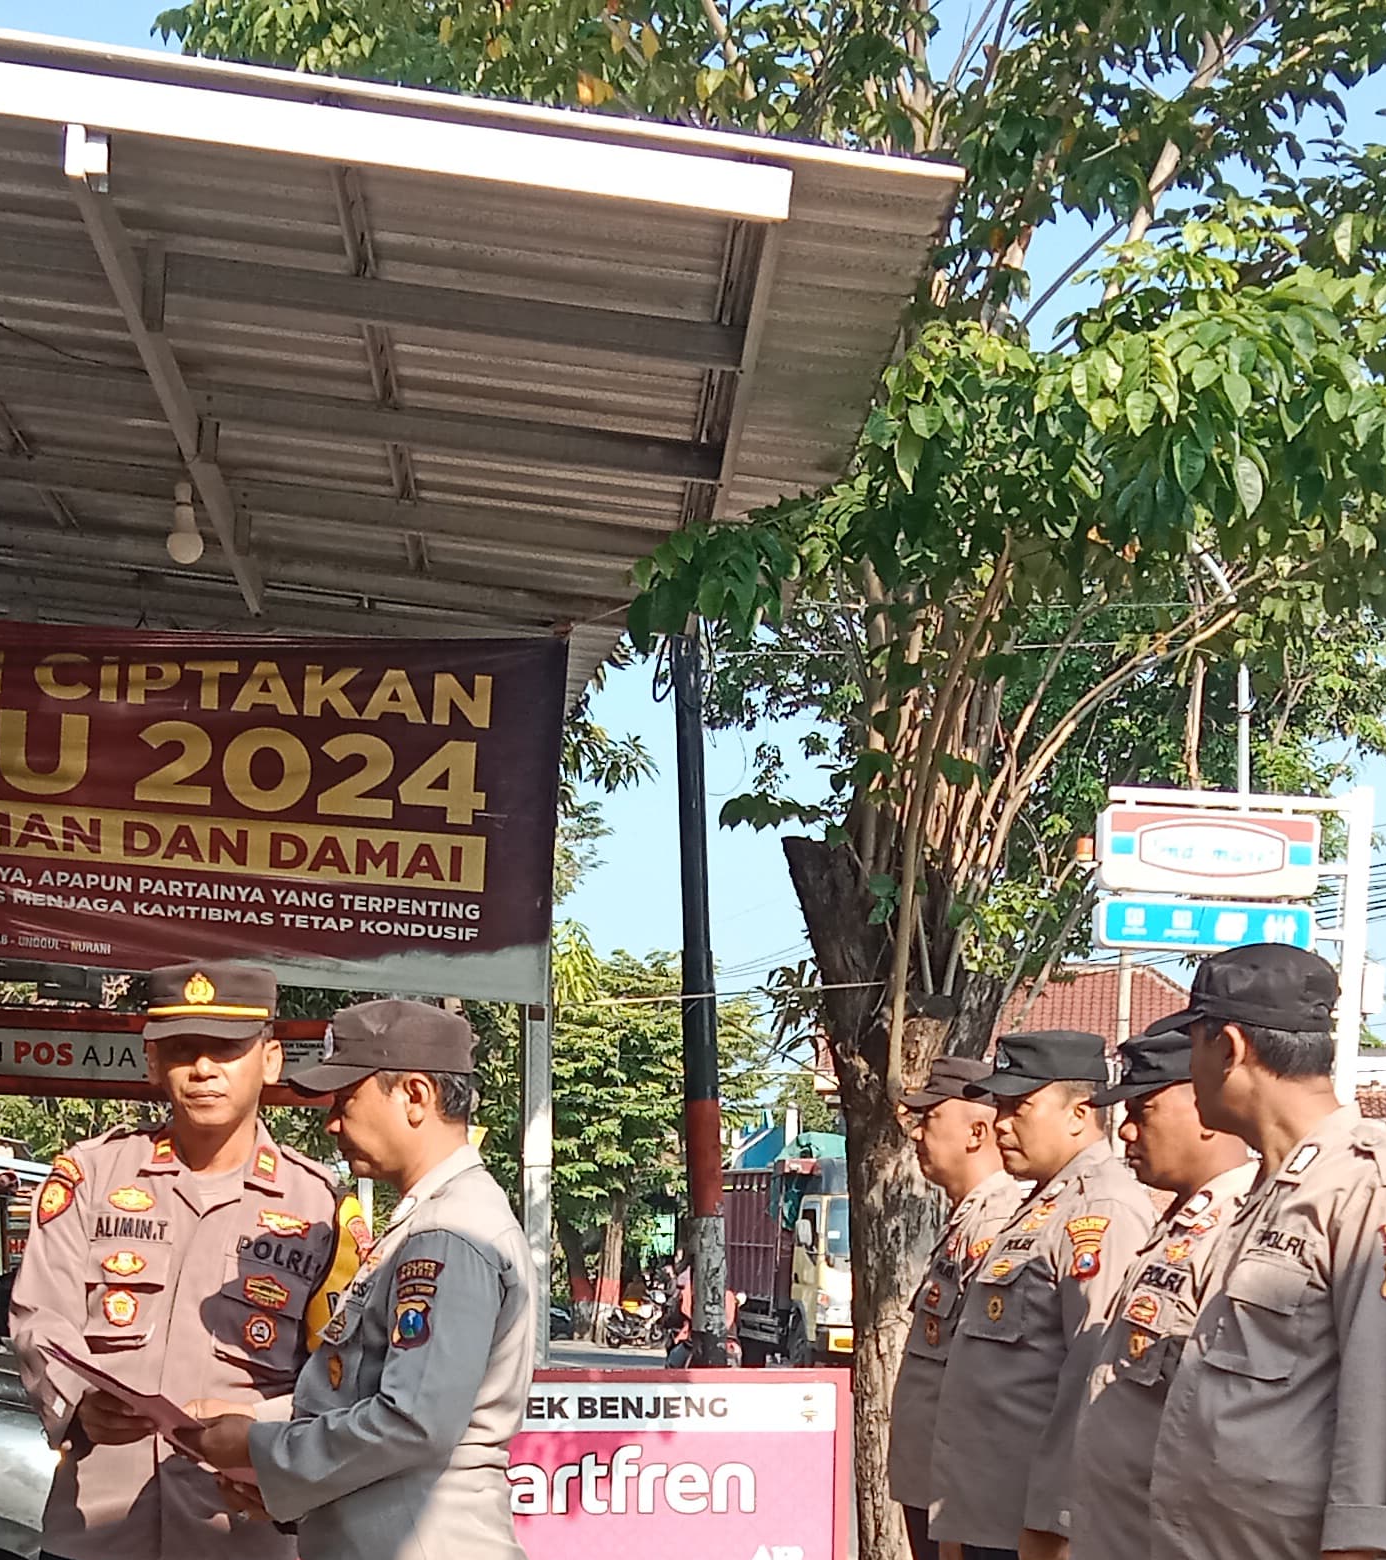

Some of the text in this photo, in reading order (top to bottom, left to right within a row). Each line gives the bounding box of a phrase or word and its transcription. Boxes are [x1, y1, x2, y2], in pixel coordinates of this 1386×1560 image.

[34, 651, 493, 729] CIPTAKAN
[133, 719, 486, 826] 2024
[122, 819, 249, 868] DAN
[269, 830, 464, 884] DAMAI
[12, 888, 128, 914] MENJAGA
[132, 901, 275, 927] KAMTIBMAS
[280, 912, 354, 932] TETAP
[359, 919, 479, 942] KONDUSIF
[38, 869, 134, 894] APAPUN
[138, 876, 265, 904] PARTAINYA
[271, 887, 335, 909] YANG
[339, 893, 481, 921] TERPENTING
[13, 1040, 74, 1067] POS
[81, 1044, 137, 1068] AJA
[94, 1216, 168, 1240] ALIMIN.T
[236, 1234, 315, 1274] POLRI
[1256, 1229, 1307, 1258] POLRI
[525, 1396, 729, 1420] EK BENJENG
[506, 1444, 757, 1516] artfren
